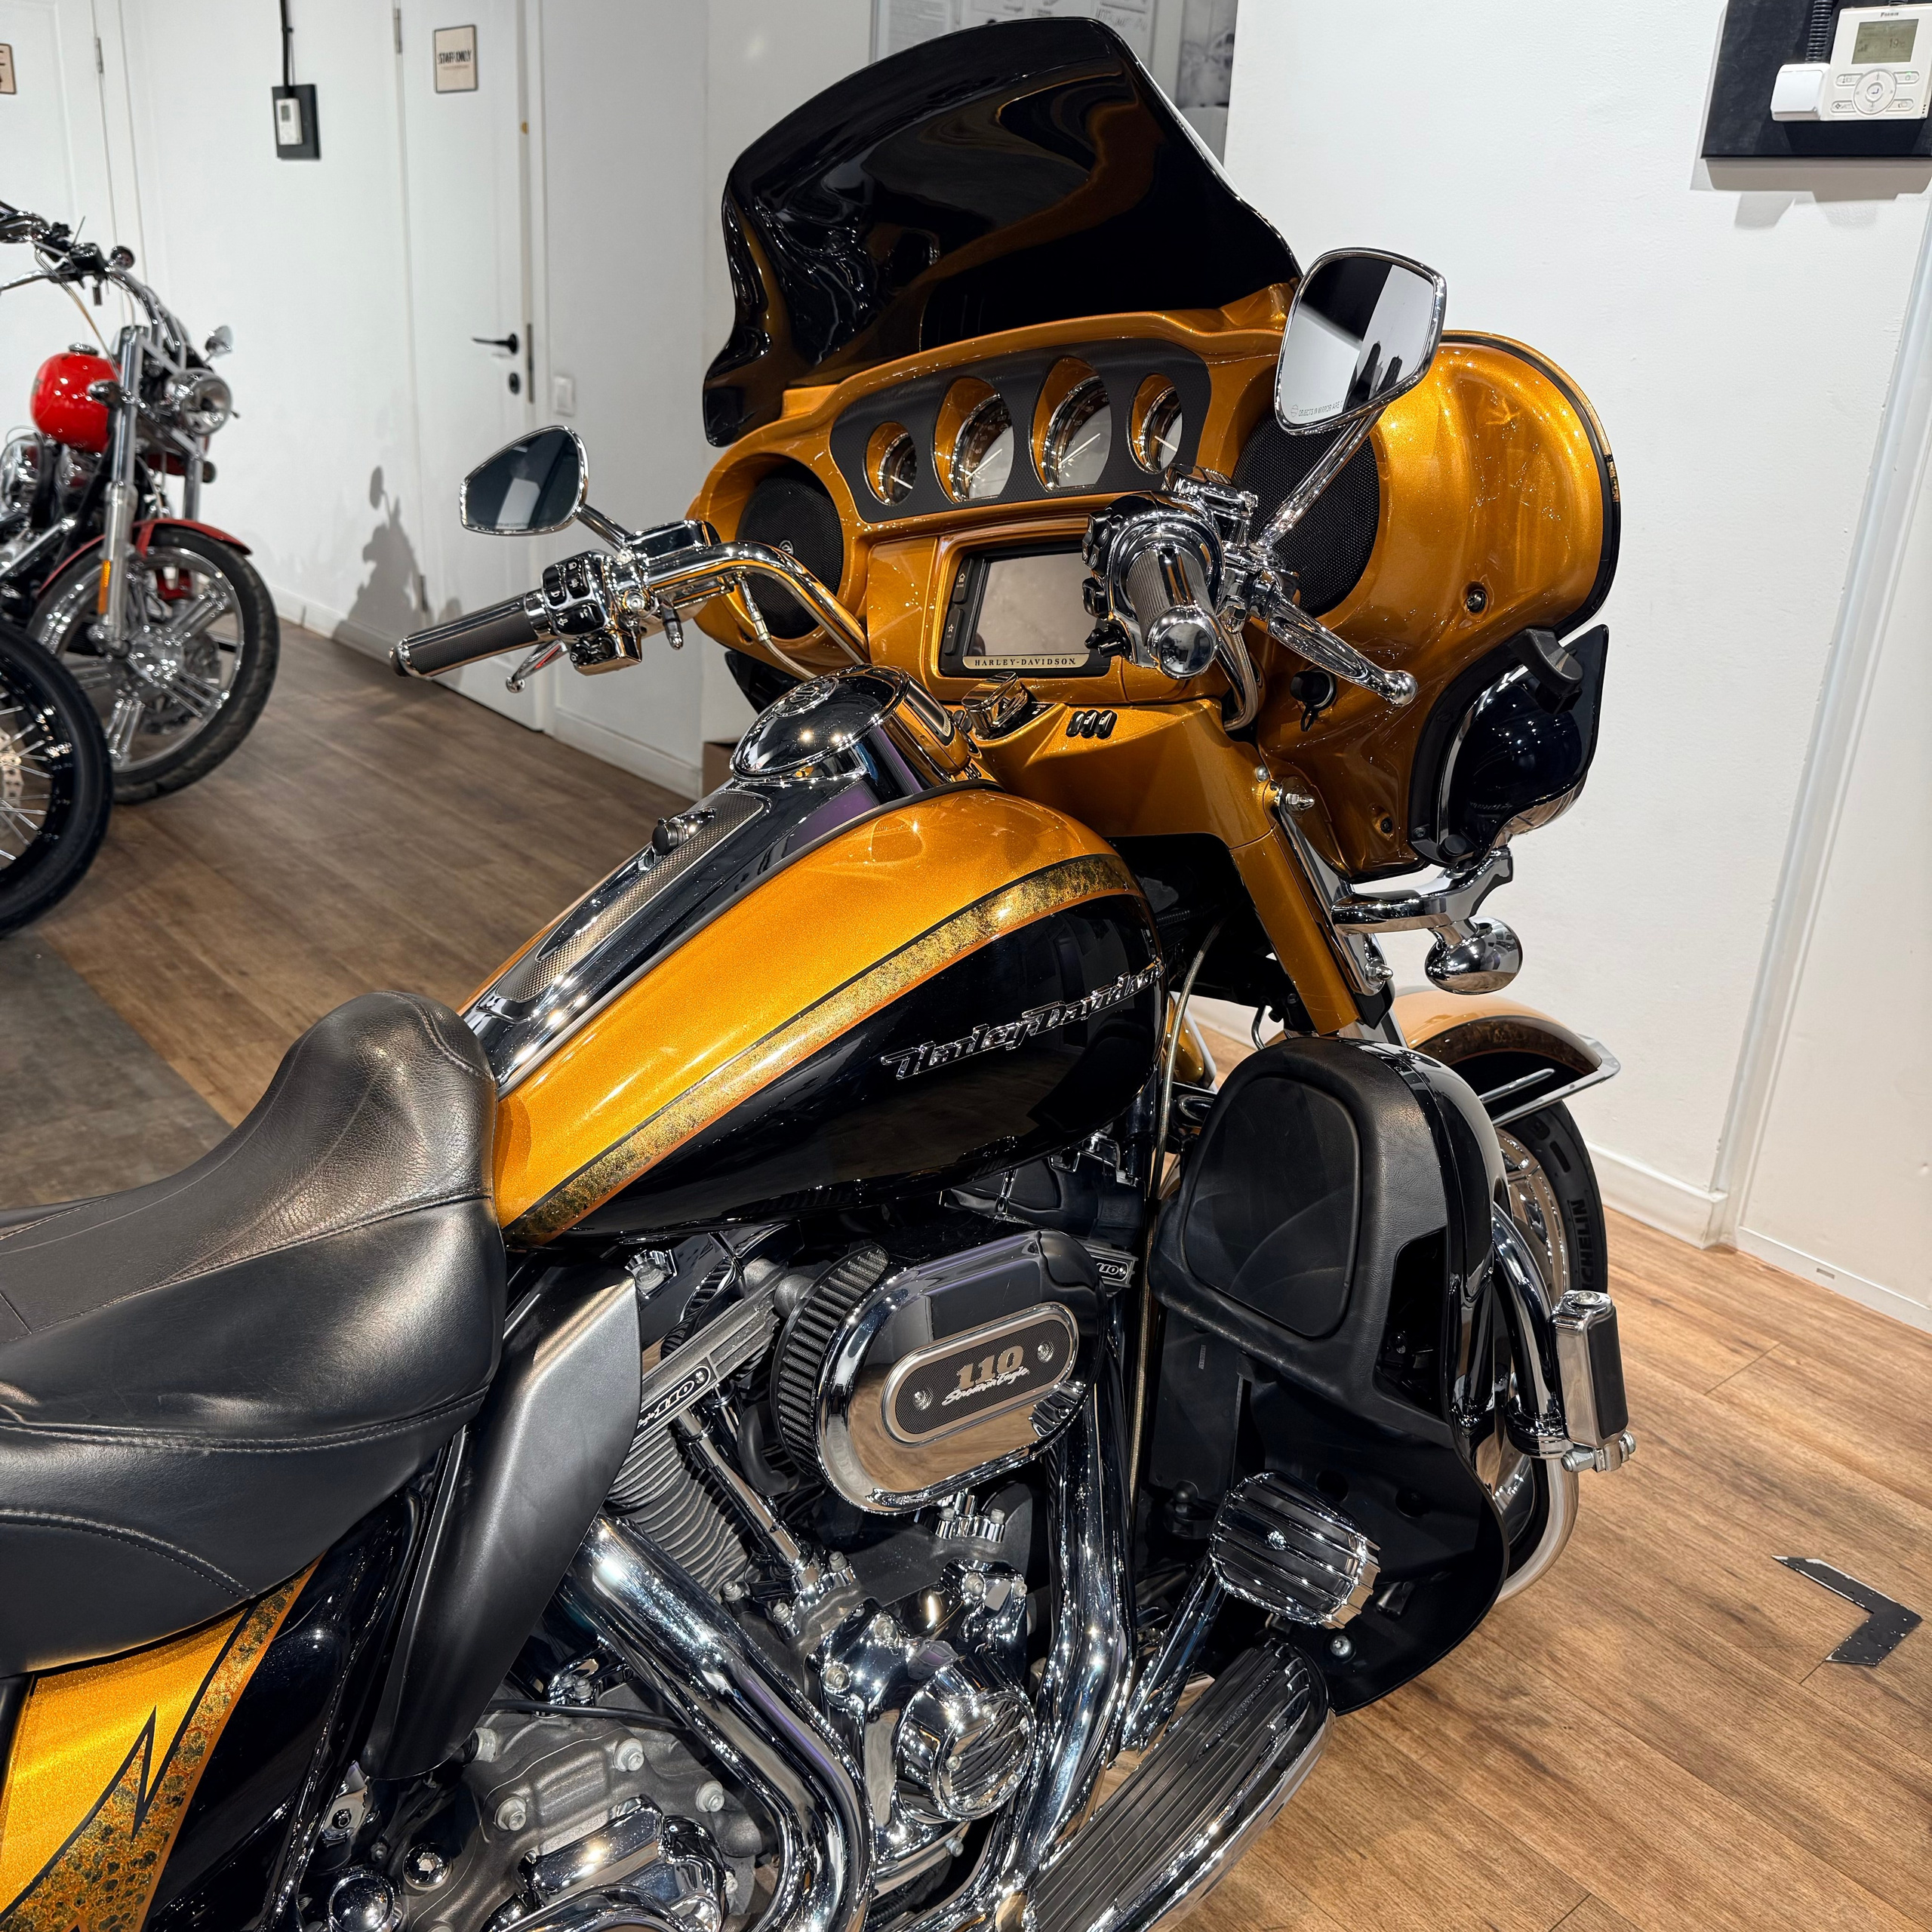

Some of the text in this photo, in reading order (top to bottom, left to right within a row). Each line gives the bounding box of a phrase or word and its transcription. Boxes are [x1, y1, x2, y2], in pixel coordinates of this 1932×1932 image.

[438, 49, 472, 64] STAFF ONLY
[1298, 408, 1313, 417] OBJECTS
[1318, 405, 1332, 414] MIRROR
[975, 658, 1076, 666] HARLEY-DAVIDSON
[1570, 1198, 1595, 1291] ICHELIN
[956, 1346, 1024, 1391] 110
[654, 1380, 694, 1419] 110
